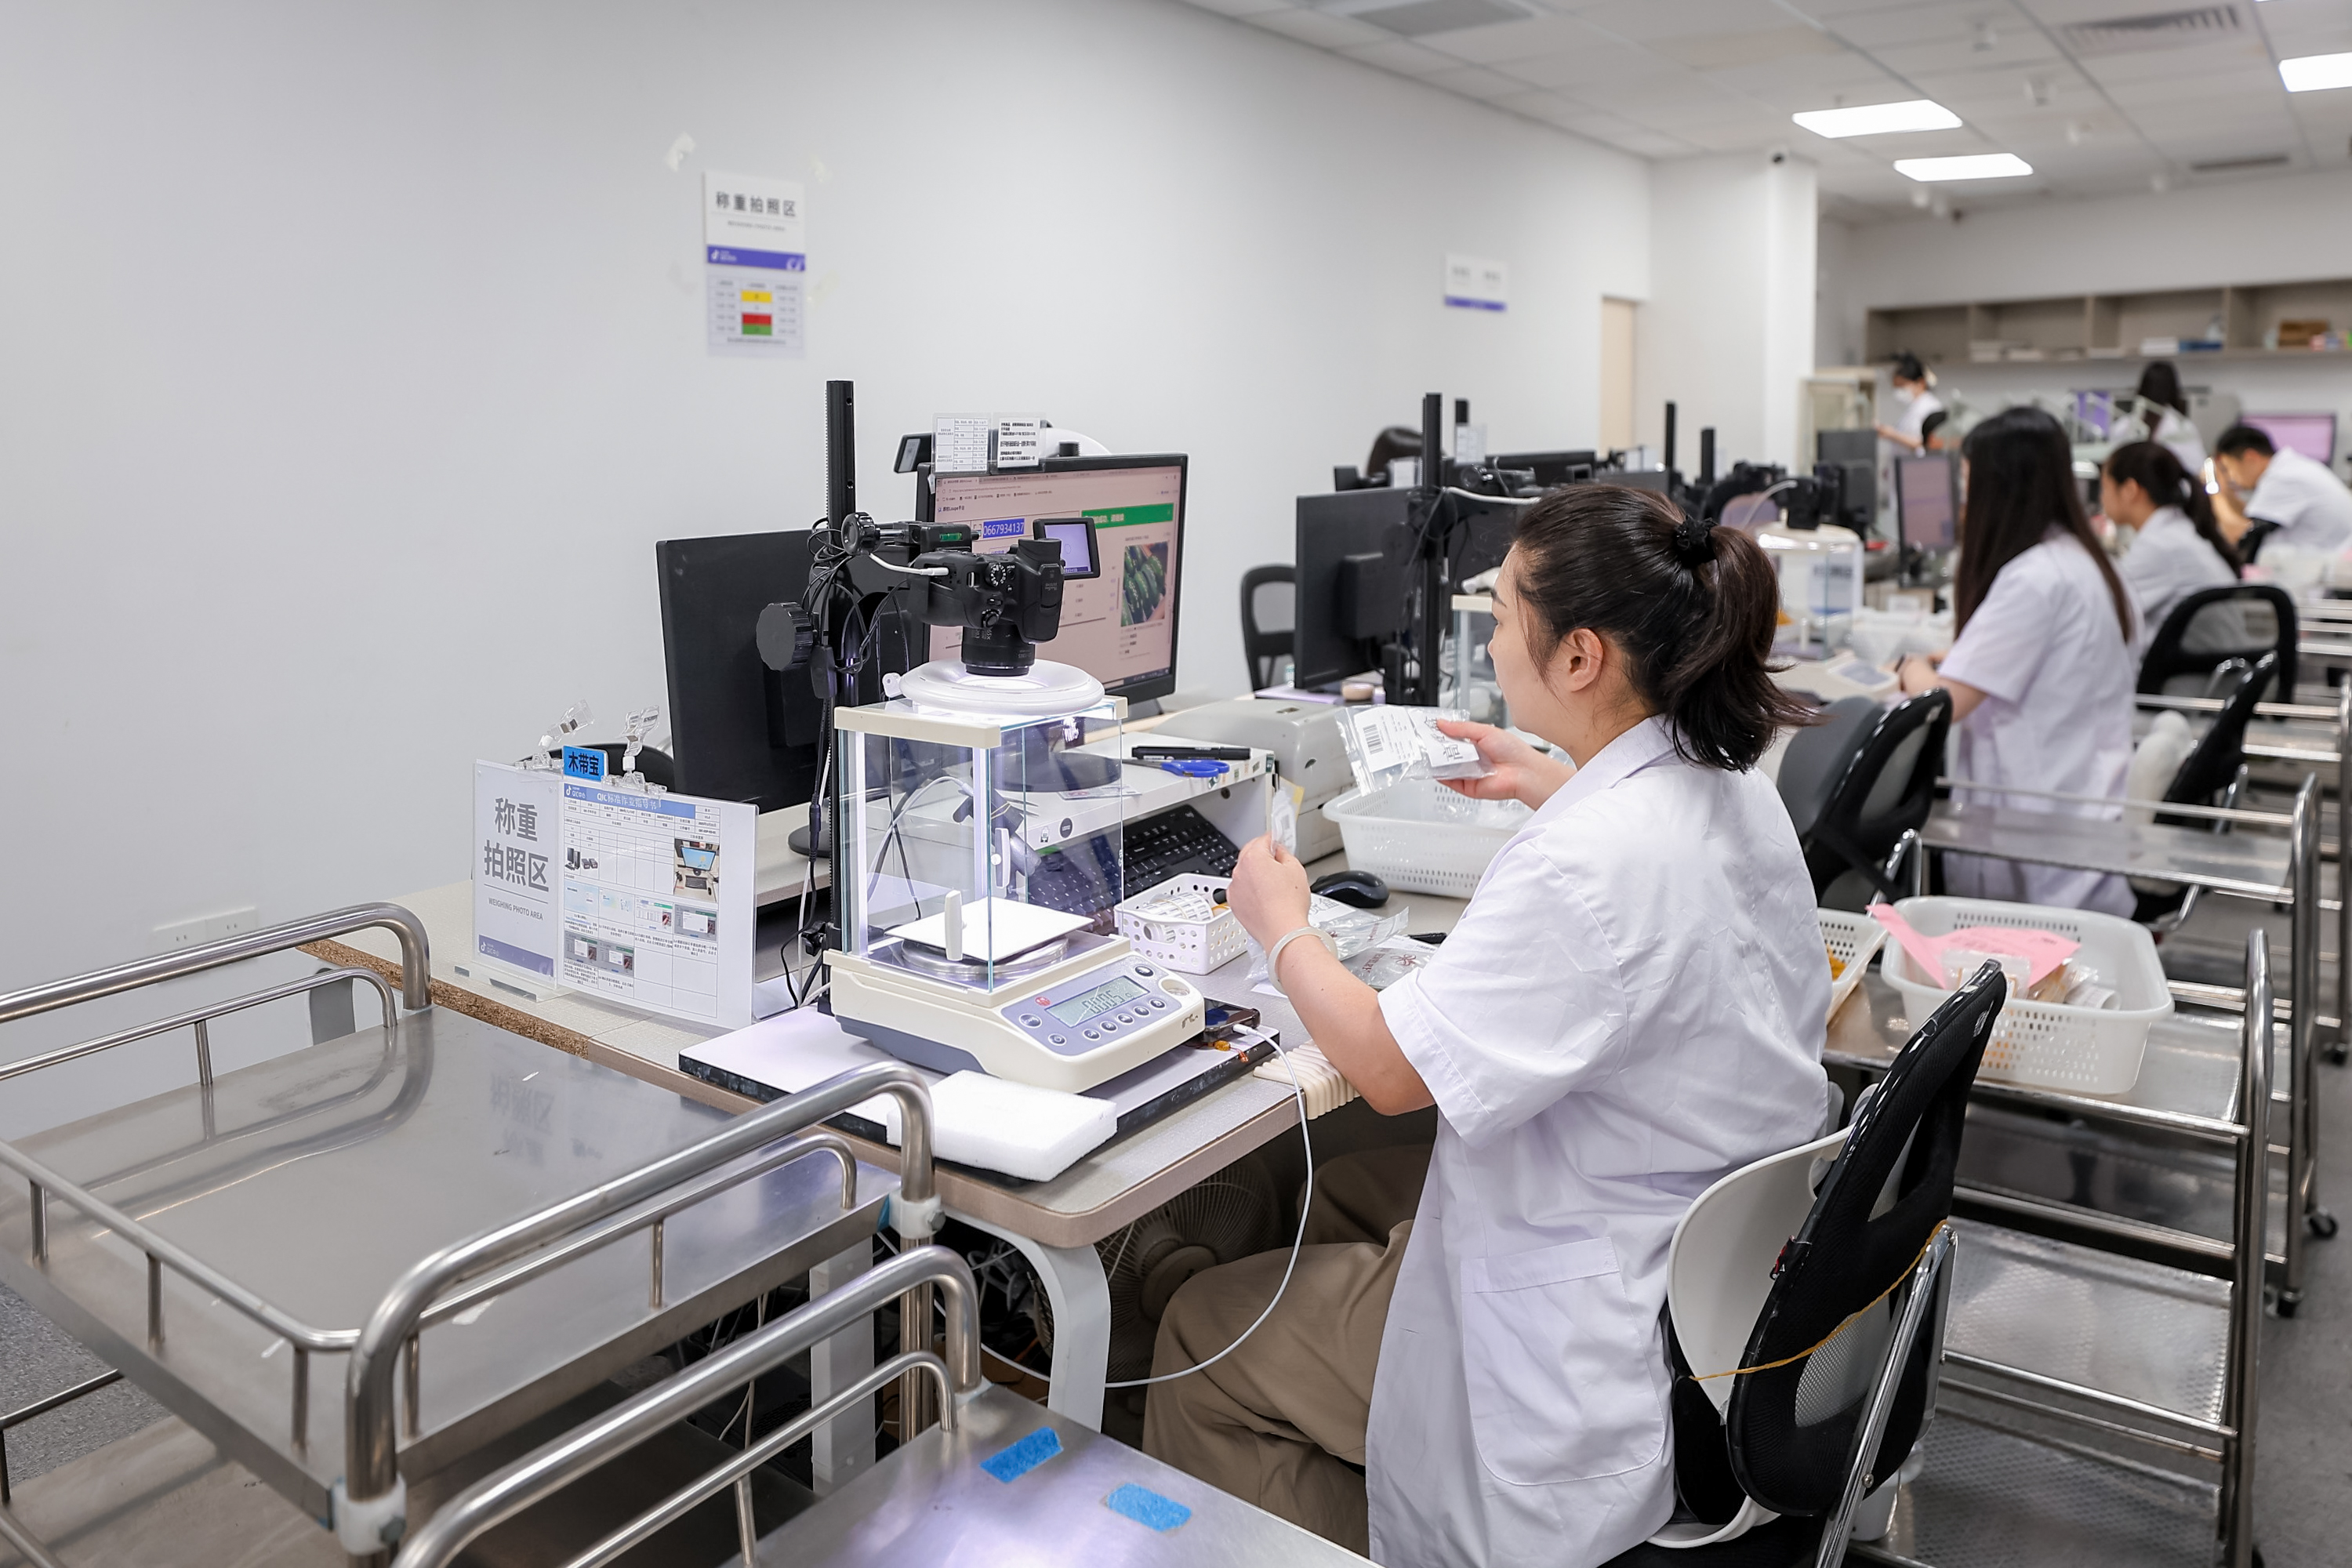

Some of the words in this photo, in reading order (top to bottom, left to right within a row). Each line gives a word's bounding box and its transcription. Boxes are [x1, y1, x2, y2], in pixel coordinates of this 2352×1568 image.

[716, 191, 796, 217] 称重拍照区
[983, 522, 1024, 535] 0667934137
[568, 751, 599, 775] 木带宝
[495, 797, 538, 842] 称重
[484, 839, 549, 892] 拍照区
[488, 897, 513, 911] WEIGHING
[513, 905, 530, 916] PHOTO
[530, 910, 544, 921] AREA
